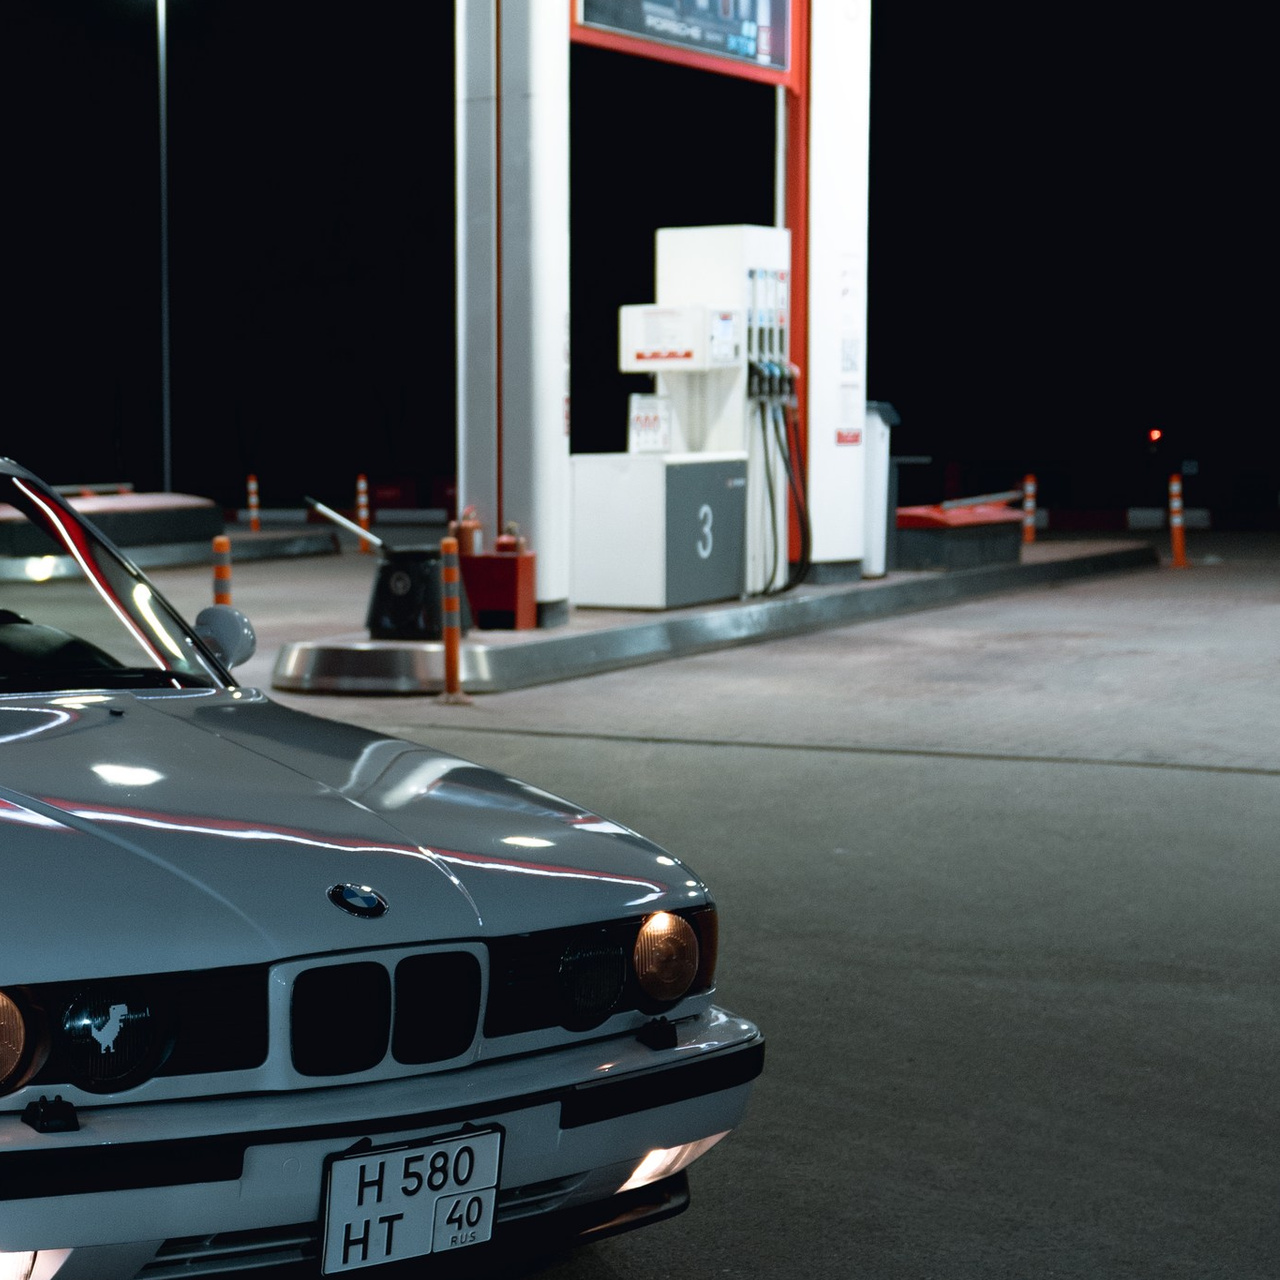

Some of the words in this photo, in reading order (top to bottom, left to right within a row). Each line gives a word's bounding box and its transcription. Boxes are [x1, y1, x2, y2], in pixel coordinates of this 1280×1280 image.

[697, 504, 713, 559] 3
[357, 1161, 385, 1206] H
[401, 1145, 474, 1196] 580
[342, 1212, 404, 1264] HT
[446, 1196, 482, 1231] 40
[450, 1231, 477, 1247] RUS
